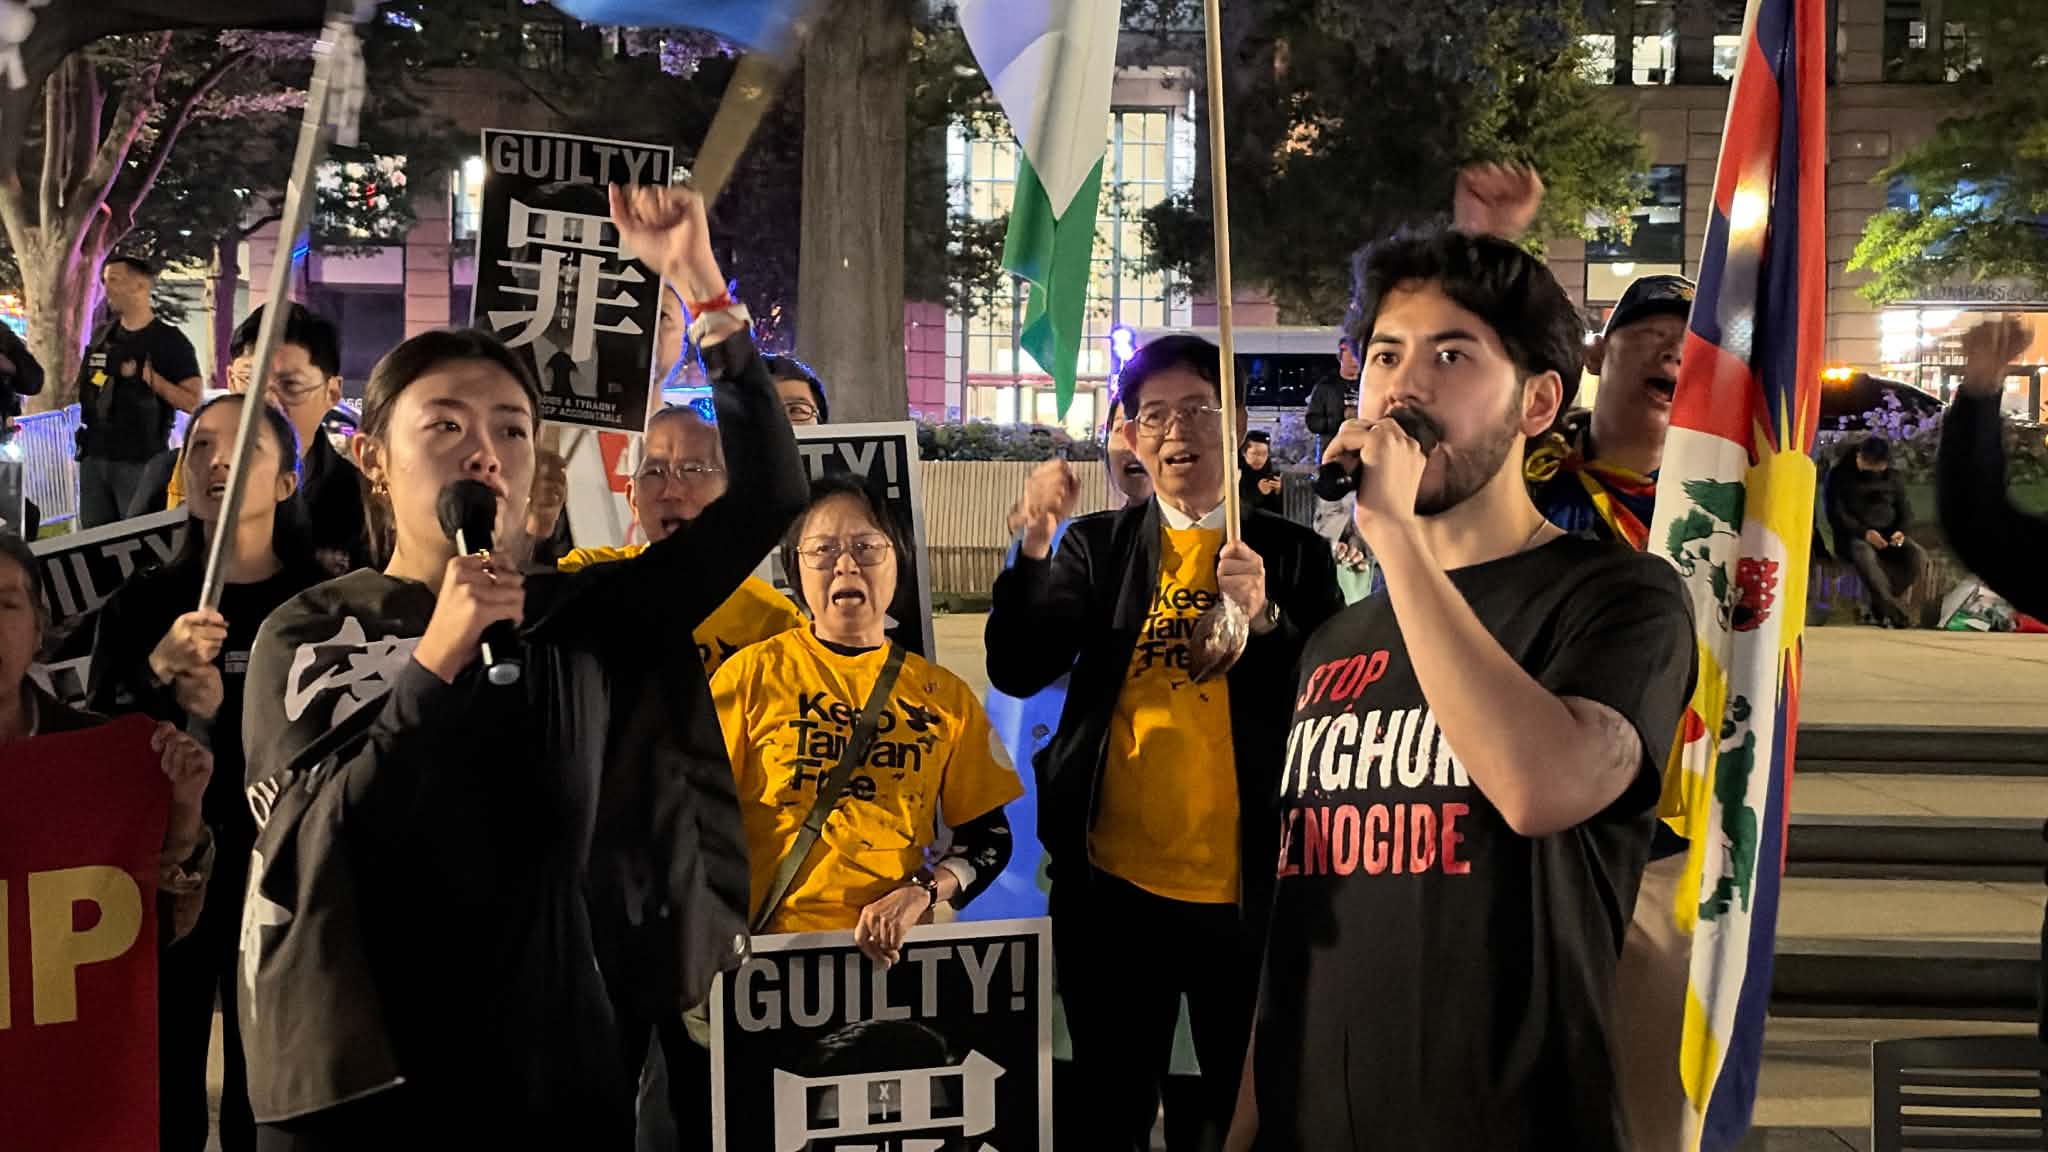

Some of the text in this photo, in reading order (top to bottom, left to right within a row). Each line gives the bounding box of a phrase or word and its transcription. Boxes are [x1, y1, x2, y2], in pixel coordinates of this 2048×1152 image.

[491, 135, 664, 187] GUILTY!
[487, 197, 647, 363] 罪
[1296, 649, 1390, 712] STOP
[788, 719, 922, 773] Taian
[734, 941, 1026, 1032] GUILTY!
